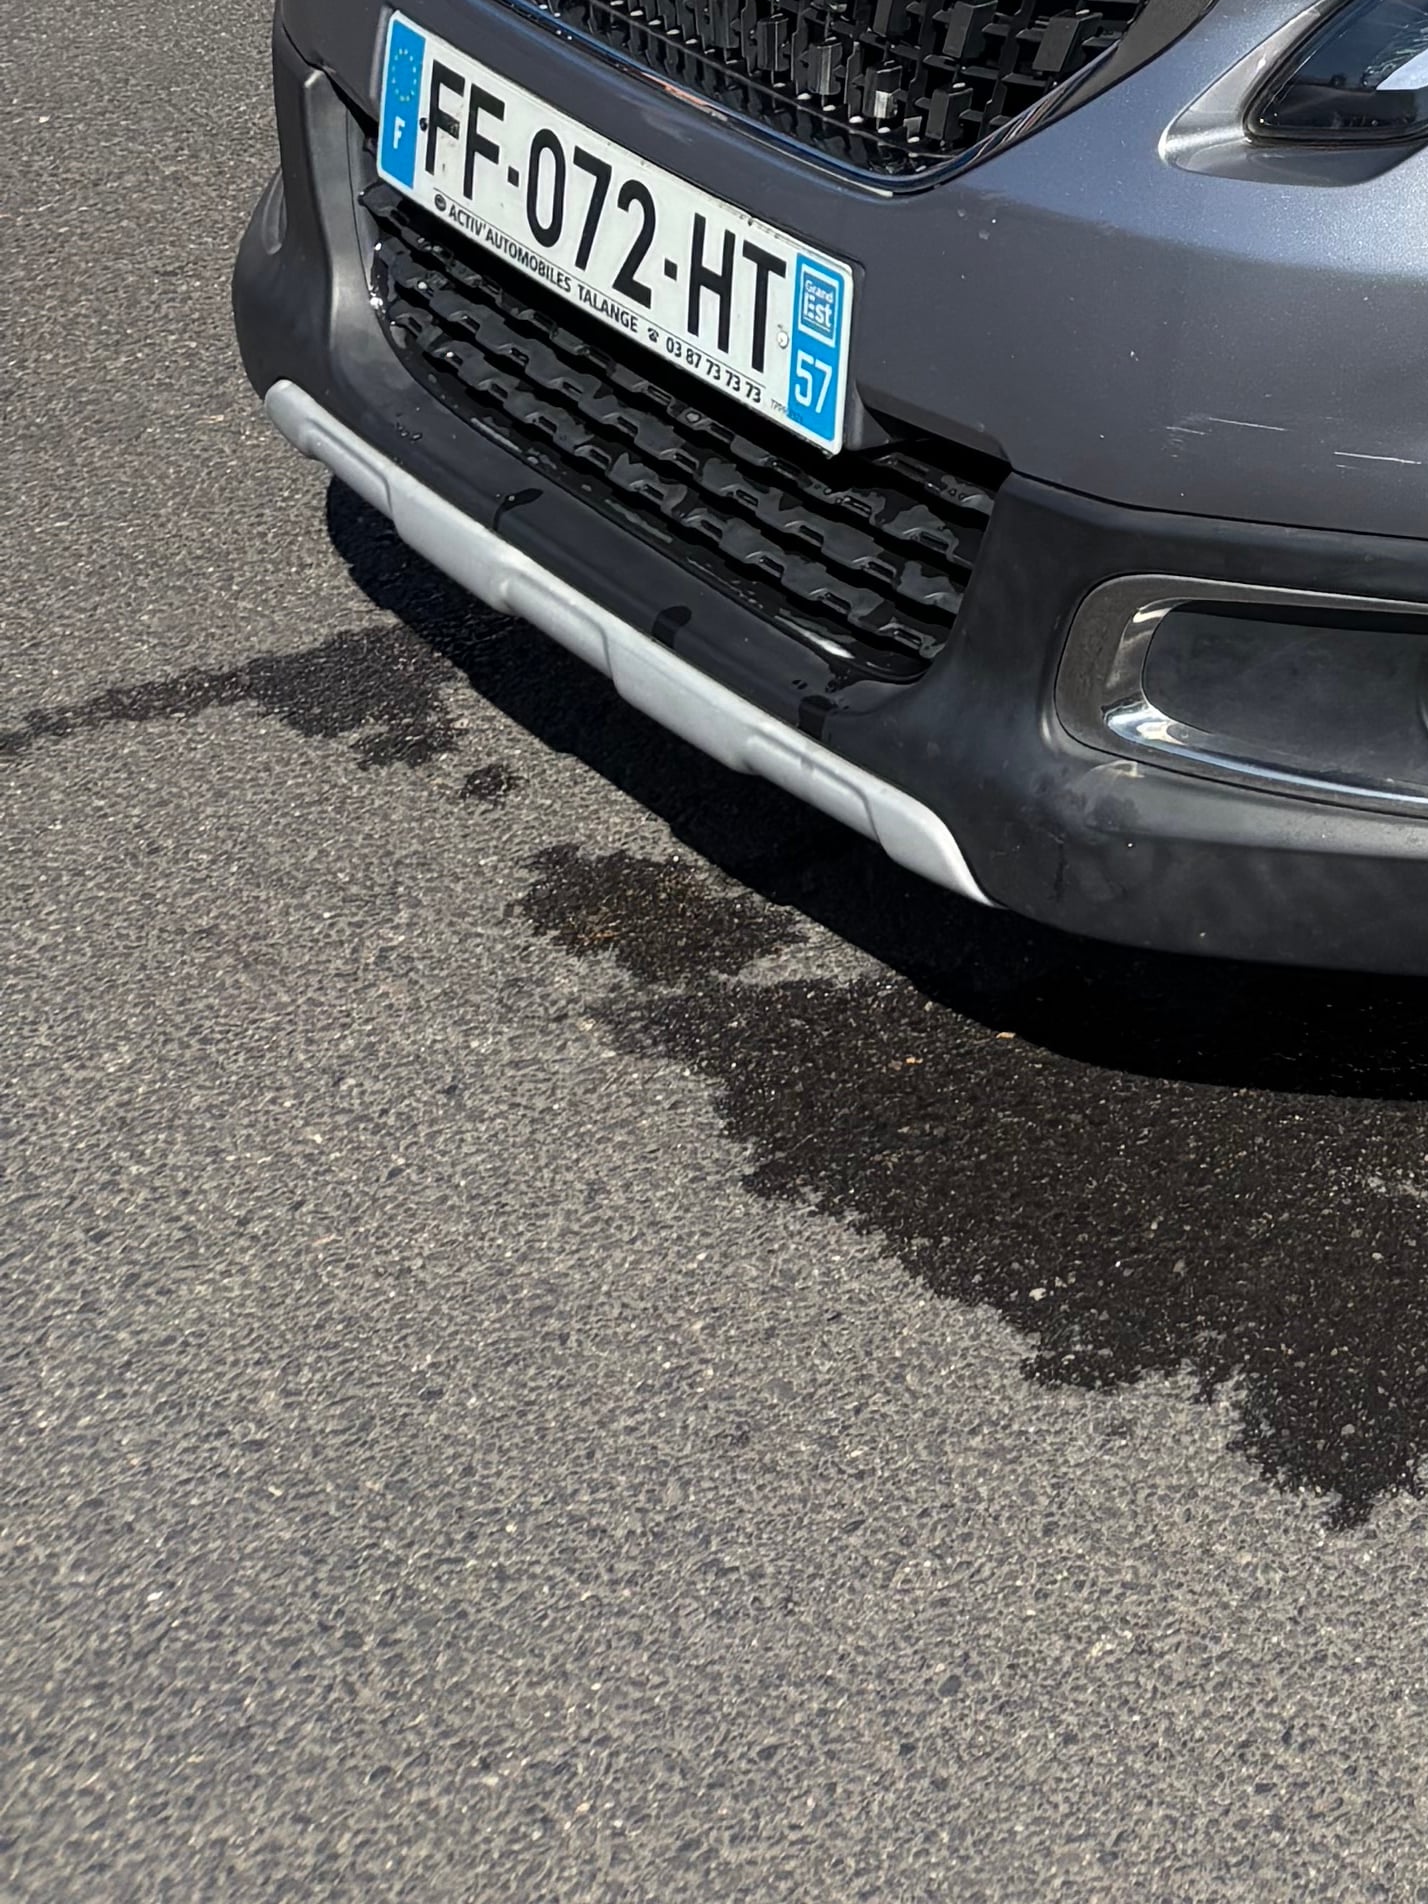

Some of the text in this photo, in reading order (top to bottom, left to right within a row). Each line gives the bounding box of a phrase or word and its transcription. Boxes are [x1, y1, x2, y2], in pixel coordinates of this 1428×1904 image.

[392, 115, 406, 150] F
[425, 59, 786, 373] FF-072-HT
[803, 292, 833, 328] Est
[804, 279, 835, 303] Grand
[577, 283, 639, 334] TALANGE
[665, 336, 682, 358] 03
[685, 348, 702, 369] 87
[705, 358, 722, 381] 73
[725, 369, 741, 392] 73
[745, 380, 761, 404] 73
[794, 348, 834, 415] 57
